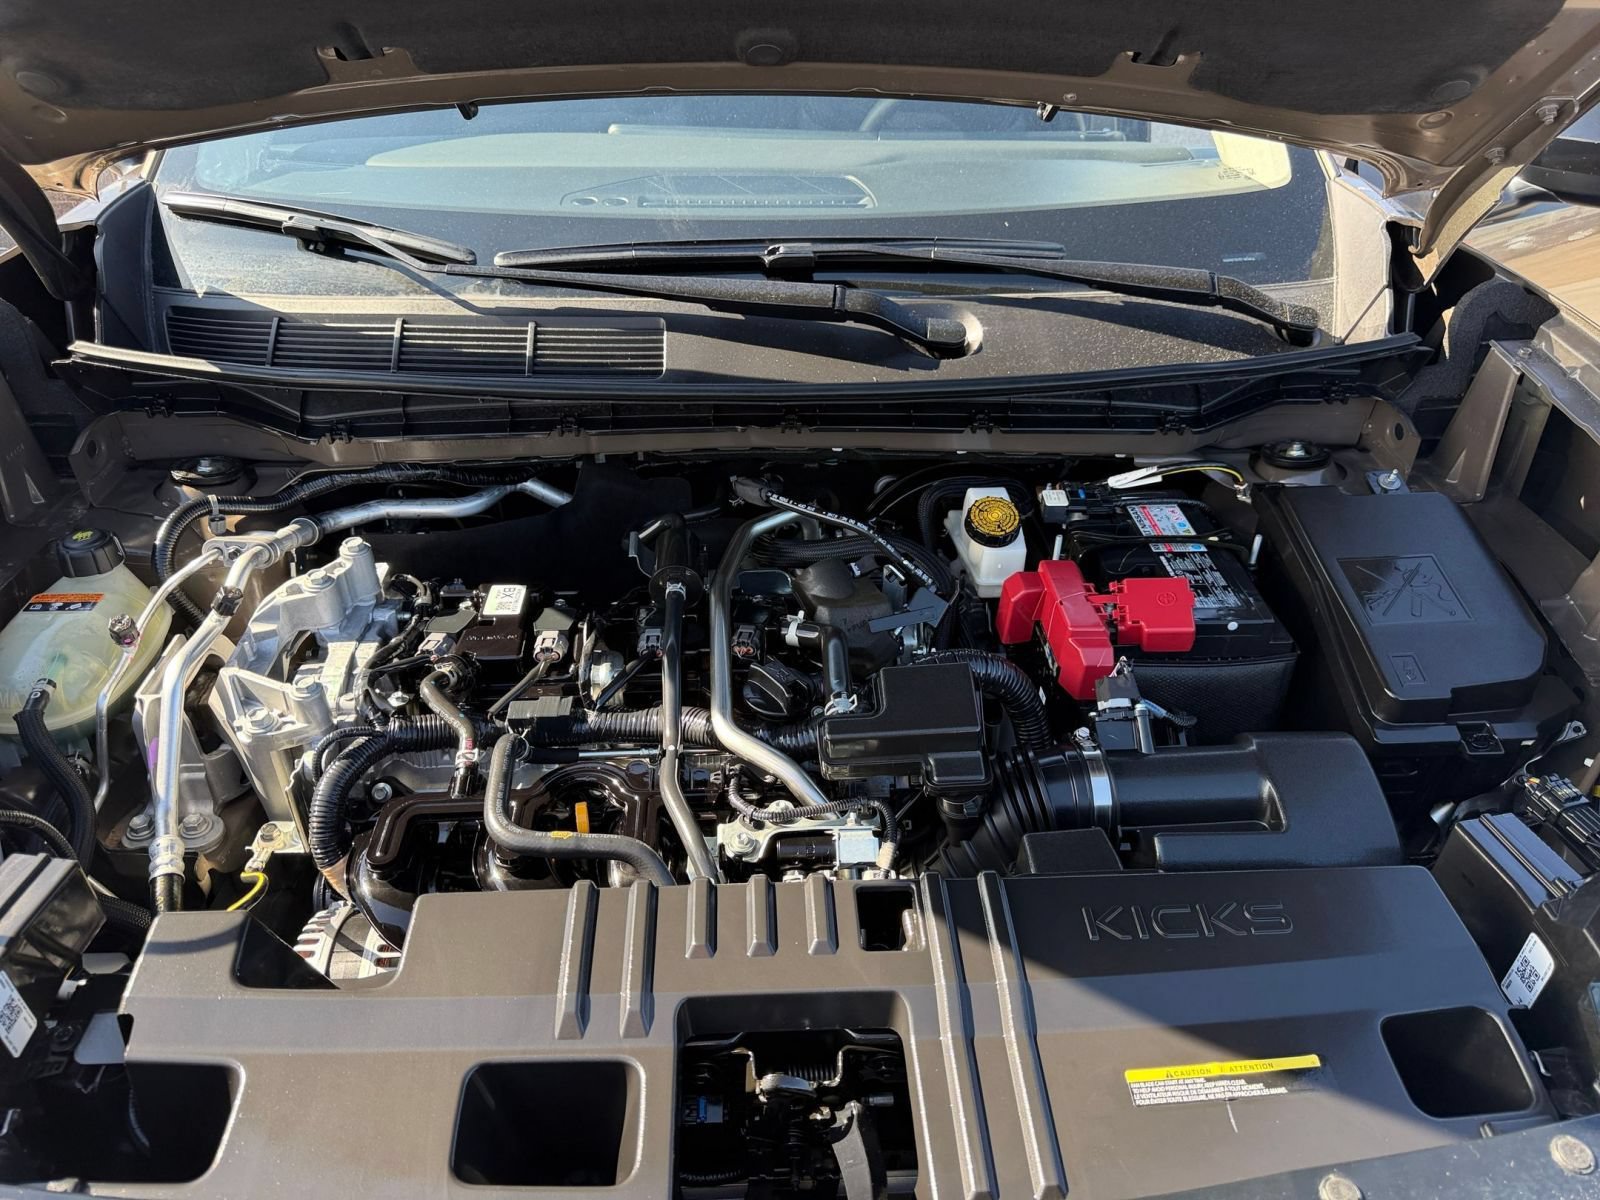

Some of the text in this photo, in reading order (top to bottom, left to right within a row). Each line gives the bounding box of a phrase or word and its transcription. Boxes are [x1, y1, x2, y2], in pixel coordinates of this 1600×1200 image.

[501, 588, 516, 599] BX
[1080, 900, 1294, 941] KICKS
[1174, 1068, 1212, 1078] CAUTION
[1229, 1062, 1274, 1073] ATTENTION
